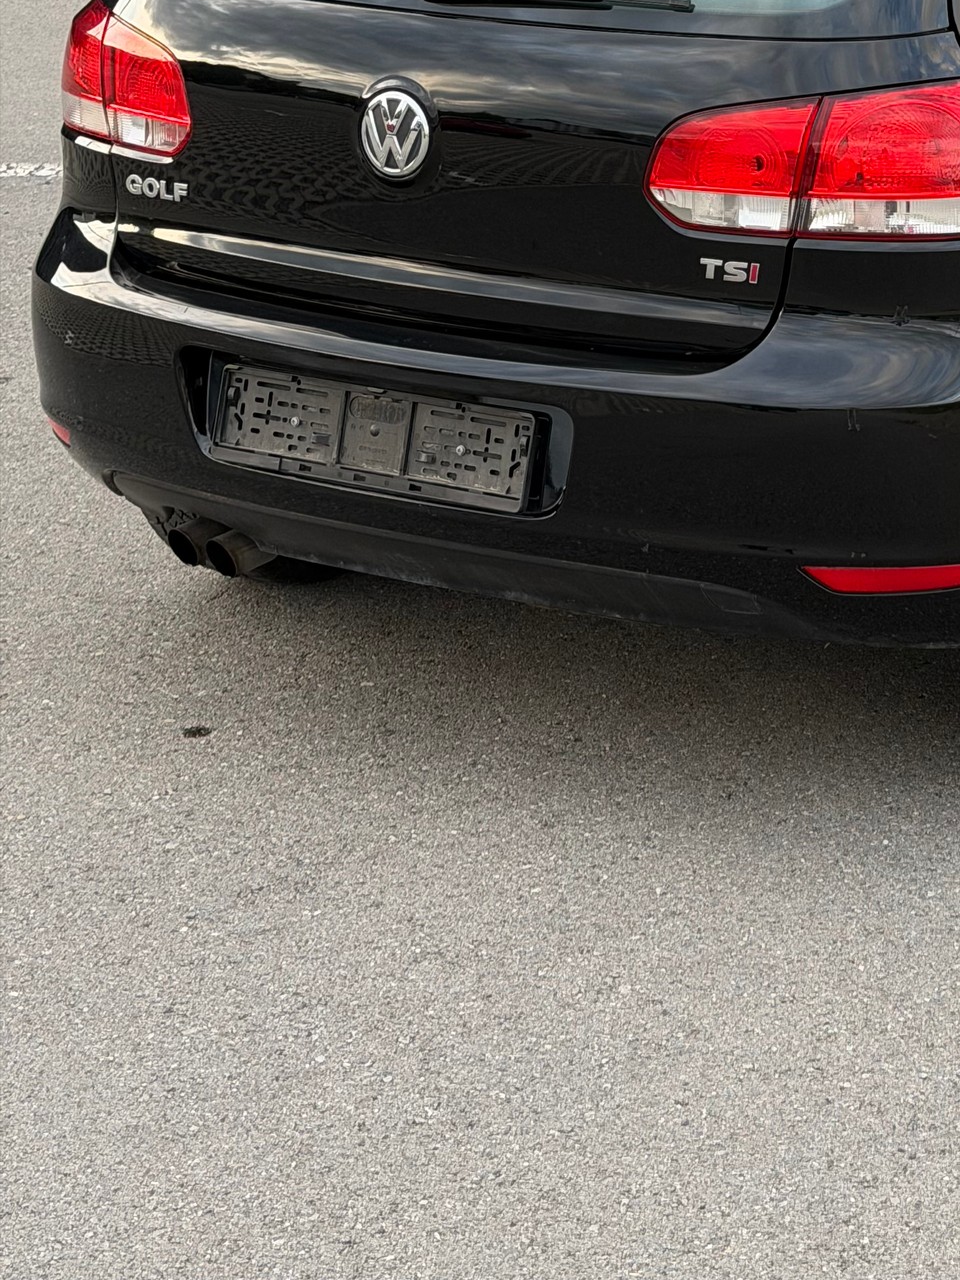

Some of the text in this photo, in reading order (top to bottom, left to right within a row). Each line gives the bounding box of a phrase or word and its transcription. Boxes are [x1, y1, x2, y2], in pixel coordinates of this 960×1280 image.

[361, 90, 430, 177] VW
[126, 173, 188, 202] GOLF
[699, 257, 761, 285] TSI
